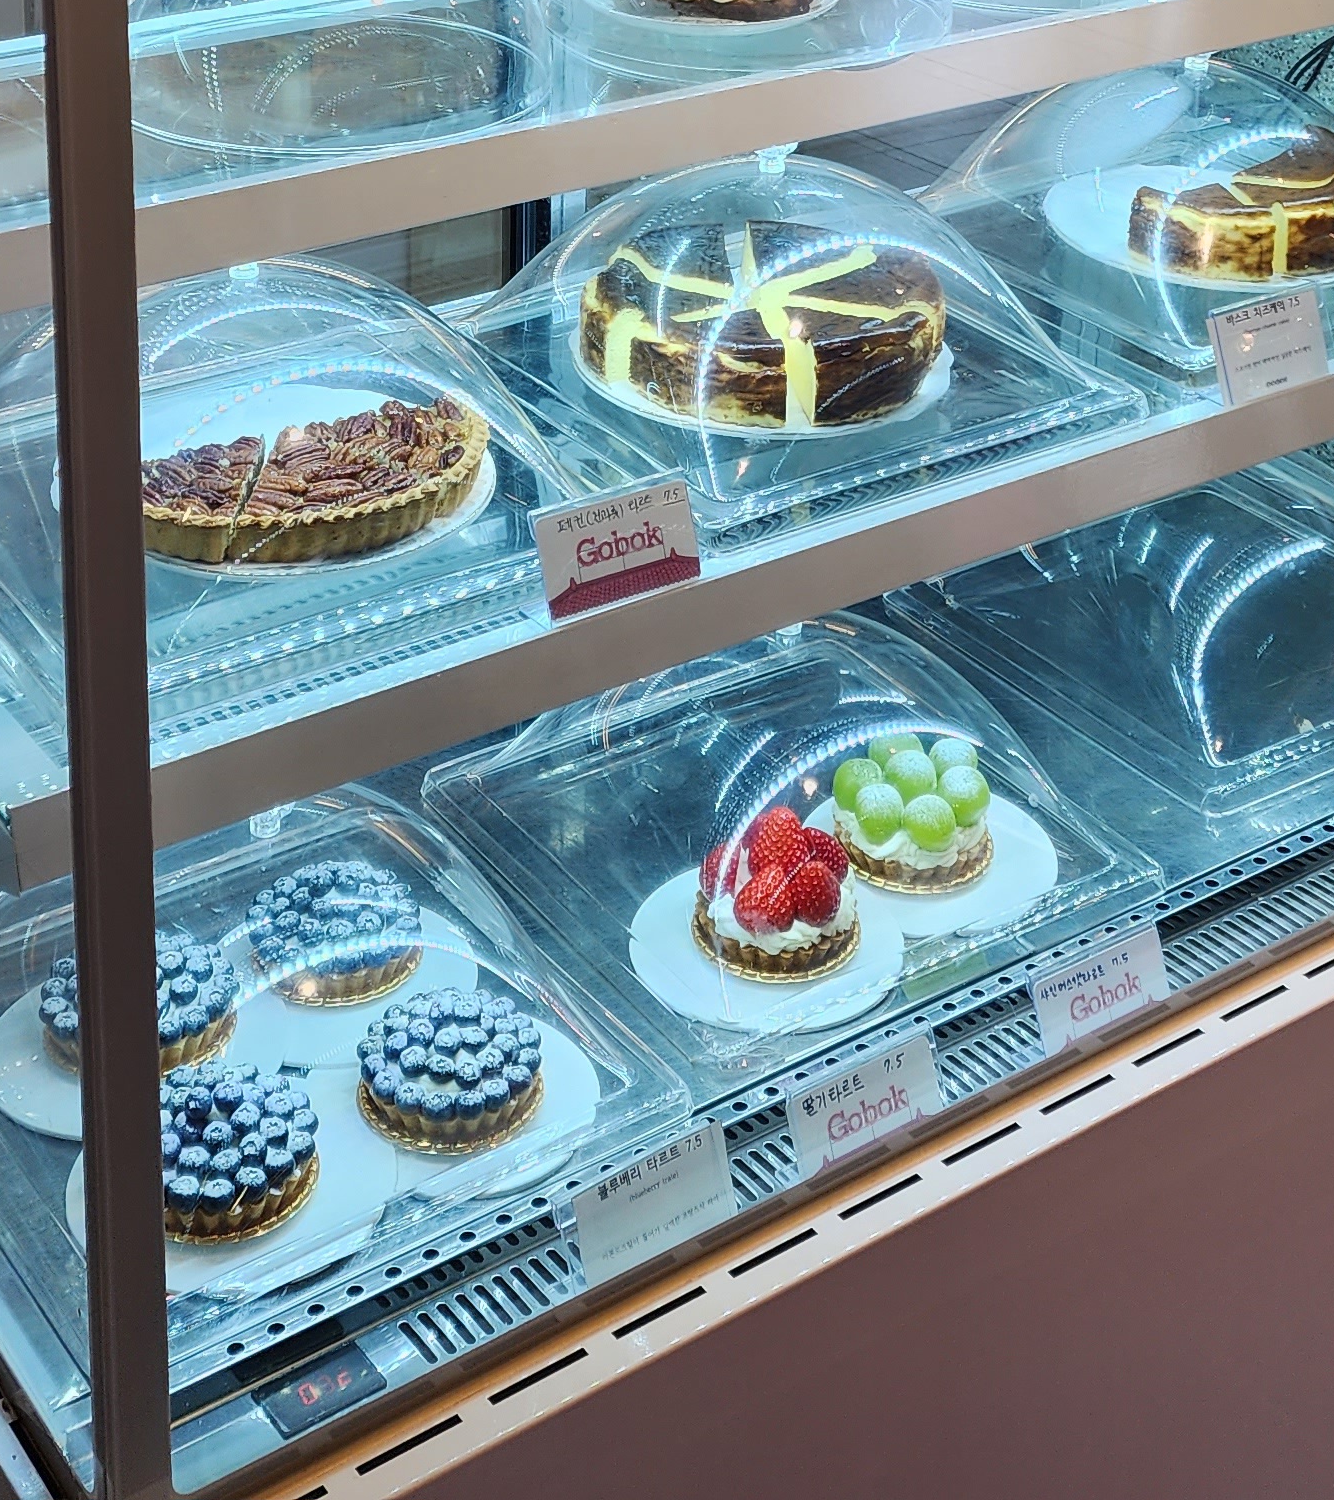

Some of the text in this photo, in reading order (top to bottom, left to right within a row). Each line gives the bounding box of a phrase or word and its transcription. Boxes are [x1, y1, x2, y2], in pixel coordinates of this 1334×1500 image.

[1225, 310, 1252, 327] 바스크
[576, 520, 664, 568] Gobok
[1070, 972, 1142, 1023] Gobok
[883, 1052, 905, 1074] 7.5
[827, 1084, 910, 1142] Gobok
[597, 1134, 703, 1201] 블루베리 타르트 7.5
